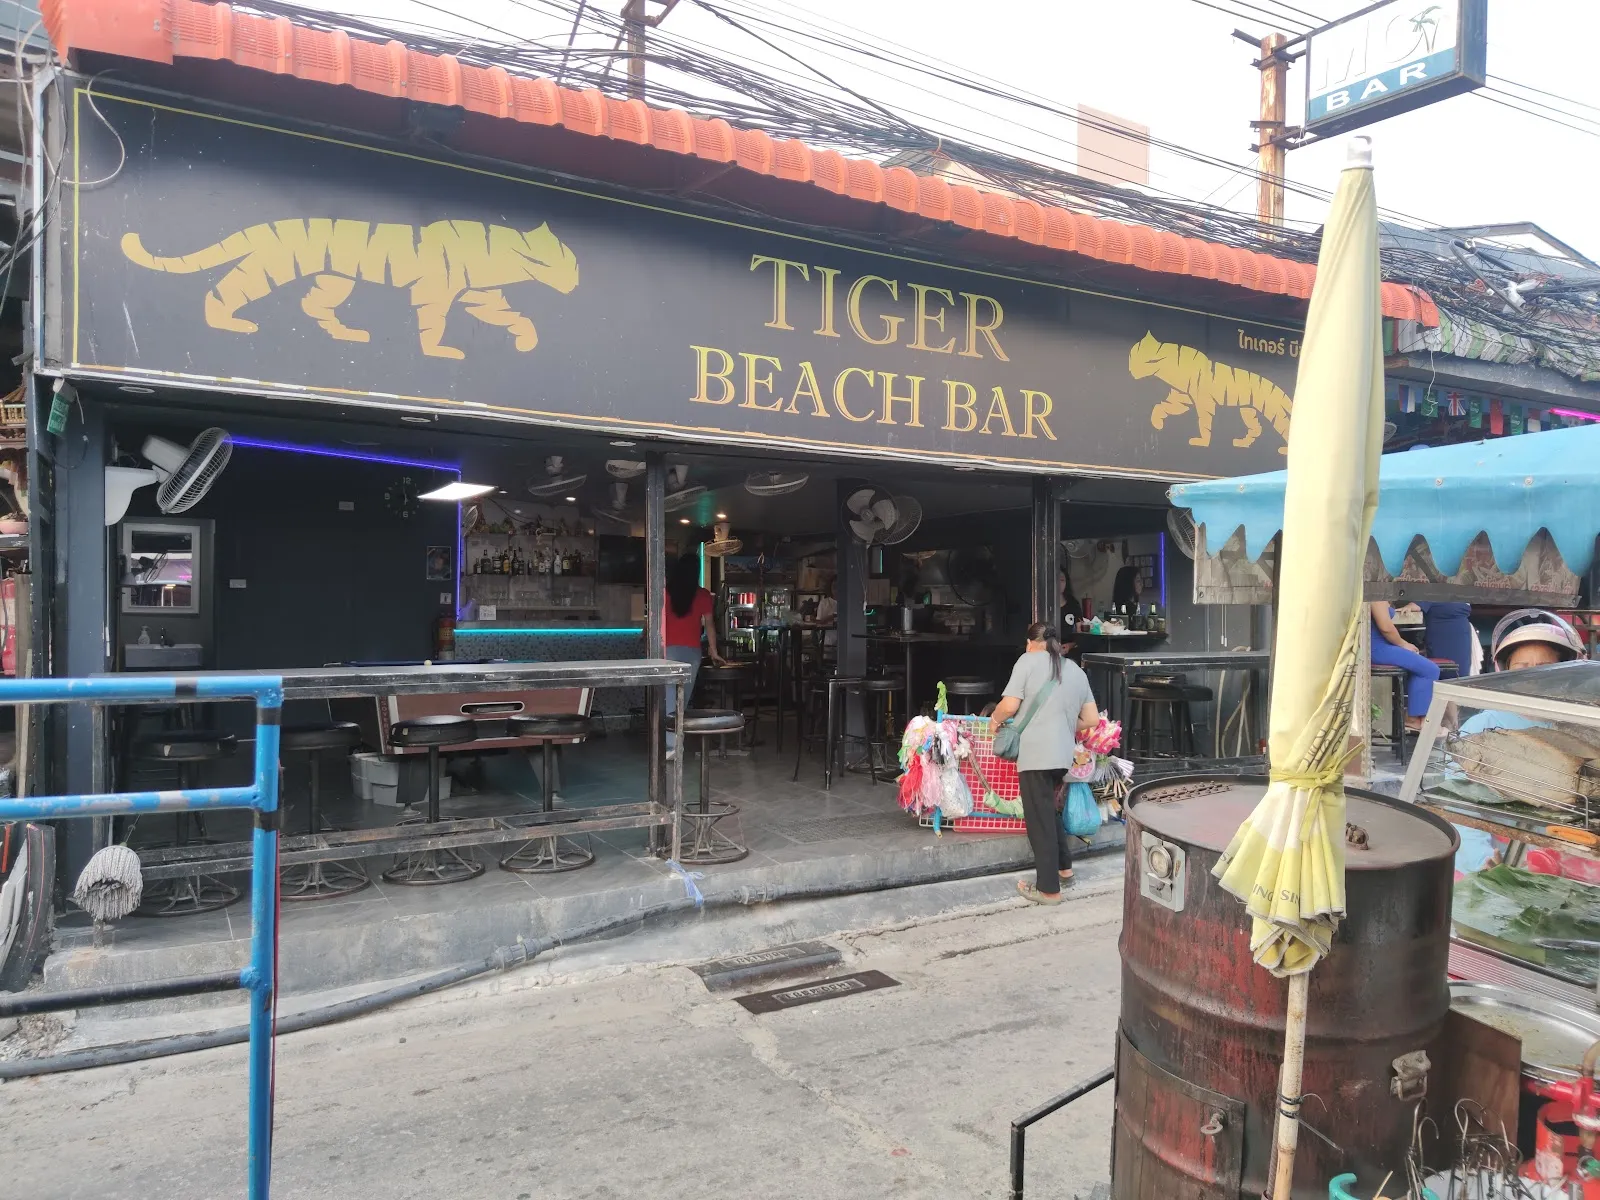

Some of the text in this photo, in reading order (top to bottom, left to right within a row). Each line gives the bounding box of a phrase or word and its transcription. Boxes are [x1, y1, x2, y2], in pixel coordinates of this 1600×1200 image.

[1326, 62, 1428, 112] BAR
[749, 253, 1011, 362] TIGER
[1237, 328, 1286, 356] ไทเกอร์
[689, 344, 1058, 441] BEACH BAR
